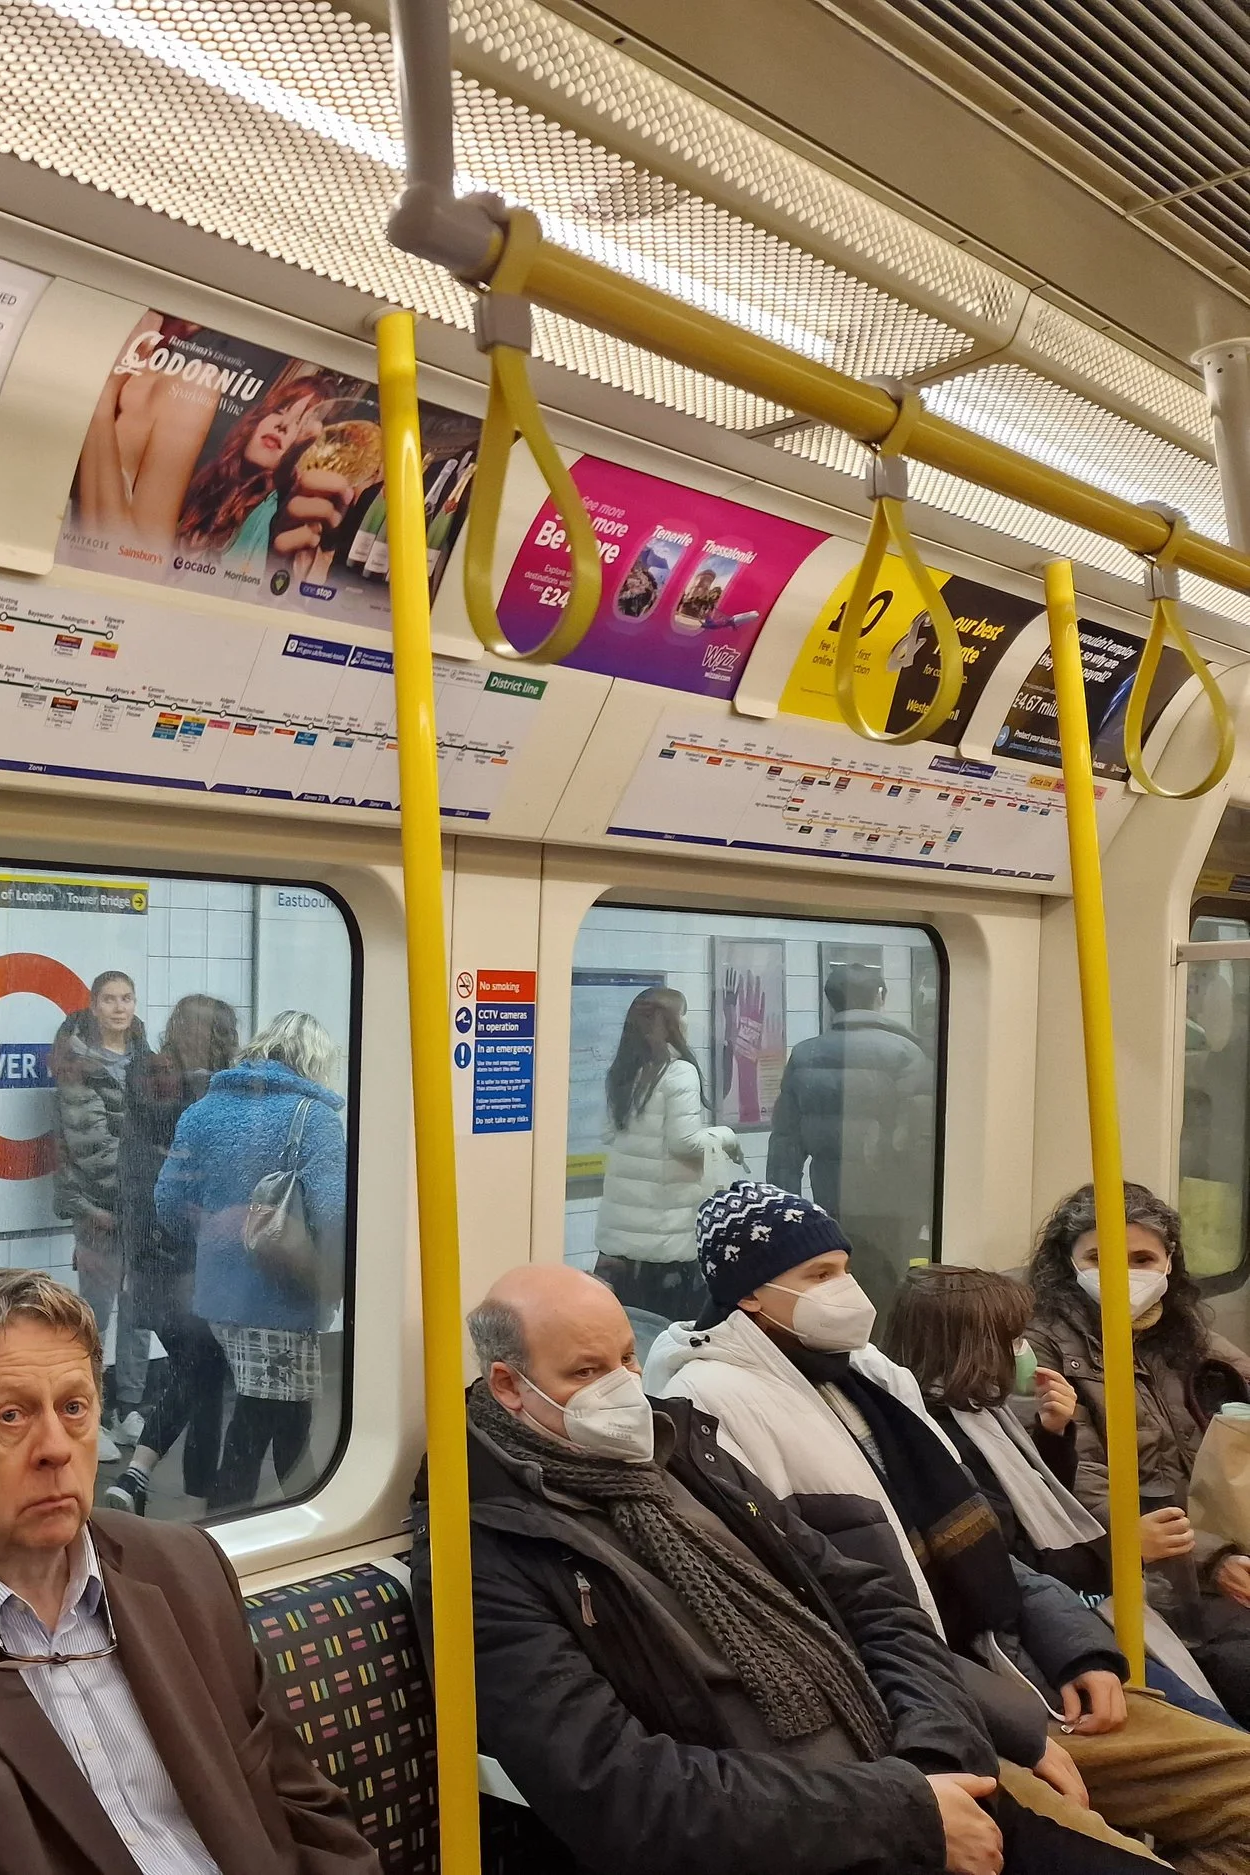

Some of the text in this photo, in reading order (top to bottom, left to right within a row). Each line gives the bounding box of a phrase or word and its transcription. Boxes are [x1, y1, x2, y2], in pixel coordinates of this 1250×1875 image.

[219, 397, 244, 417] Wine
[598, 503, 626, 518] more
[62, 532, 110, 550] WAITROSE
[534, 520, 567, 550] Be
[652, 525, 693, 547] Tenerife
[118, 545, 163, 565] Sainsbury's
[702, 539, 758, 565] Thessaloniki
[184, 559, 217, 576] ocado
[224, 570, 262, 586] Morrisons
[973, 618, 1006, 641] best
[1107, 643, 1138, 660] employ
[812, 655, 834, 667] online
[1104, 659, 1120, 669] are
[490, 676, 522, 692] District
[521, 682, 539, 695] Line
[1012, 692, 1043, 711] £4.67
[28, 763, 43, 772] Zone
[1, 887, 14, 900] of
[16, 888, 54, 903] London
[66, 891, 97, 905] Tower
[100, 894, 131, 909] Bridge
[479, 981, 520, 993] No smoking
[478, 1009, 527, 1019] CCTV cameras
[477, 1021, 519, 1033] in operation
[477, 1044, 533, 1054] In an emergency
[476, 1117, 483, 1125] Do
[507, 1117, 516, 1125] any
